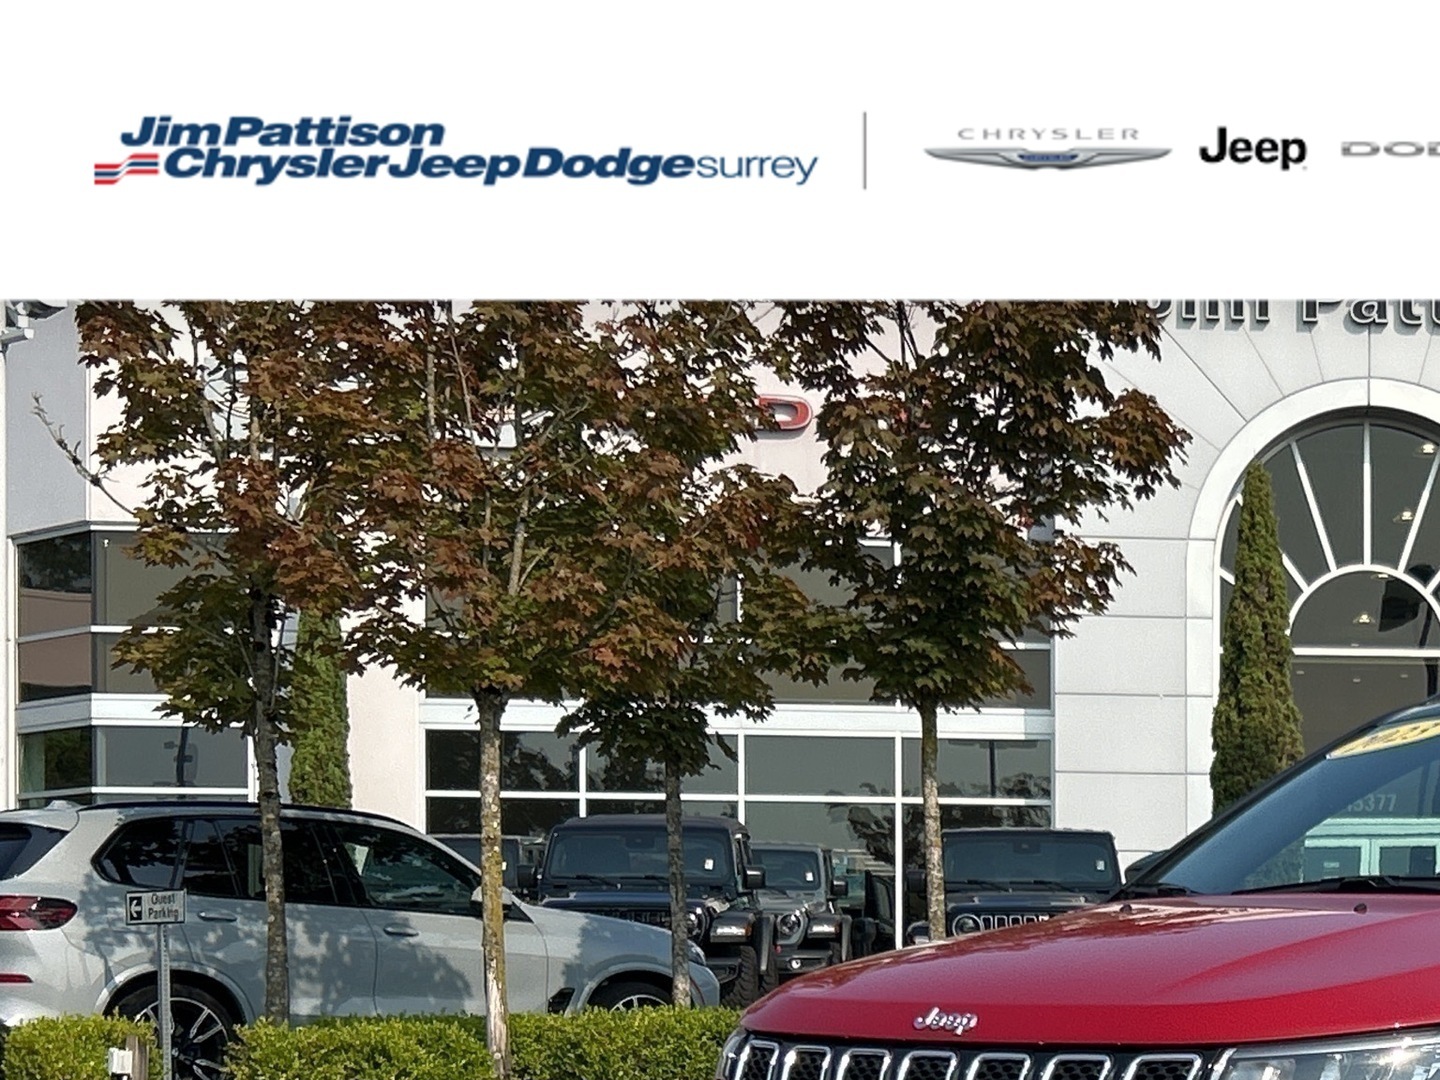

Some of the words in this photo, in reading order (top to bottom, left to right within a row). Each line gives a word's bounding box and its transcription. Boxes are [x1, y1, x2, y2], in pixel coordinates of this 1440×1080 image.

[151, 893, 176, 905] Guest
[148, 907, 179, 921] Parking
[913, 1006, 978, 1035] Jeep
